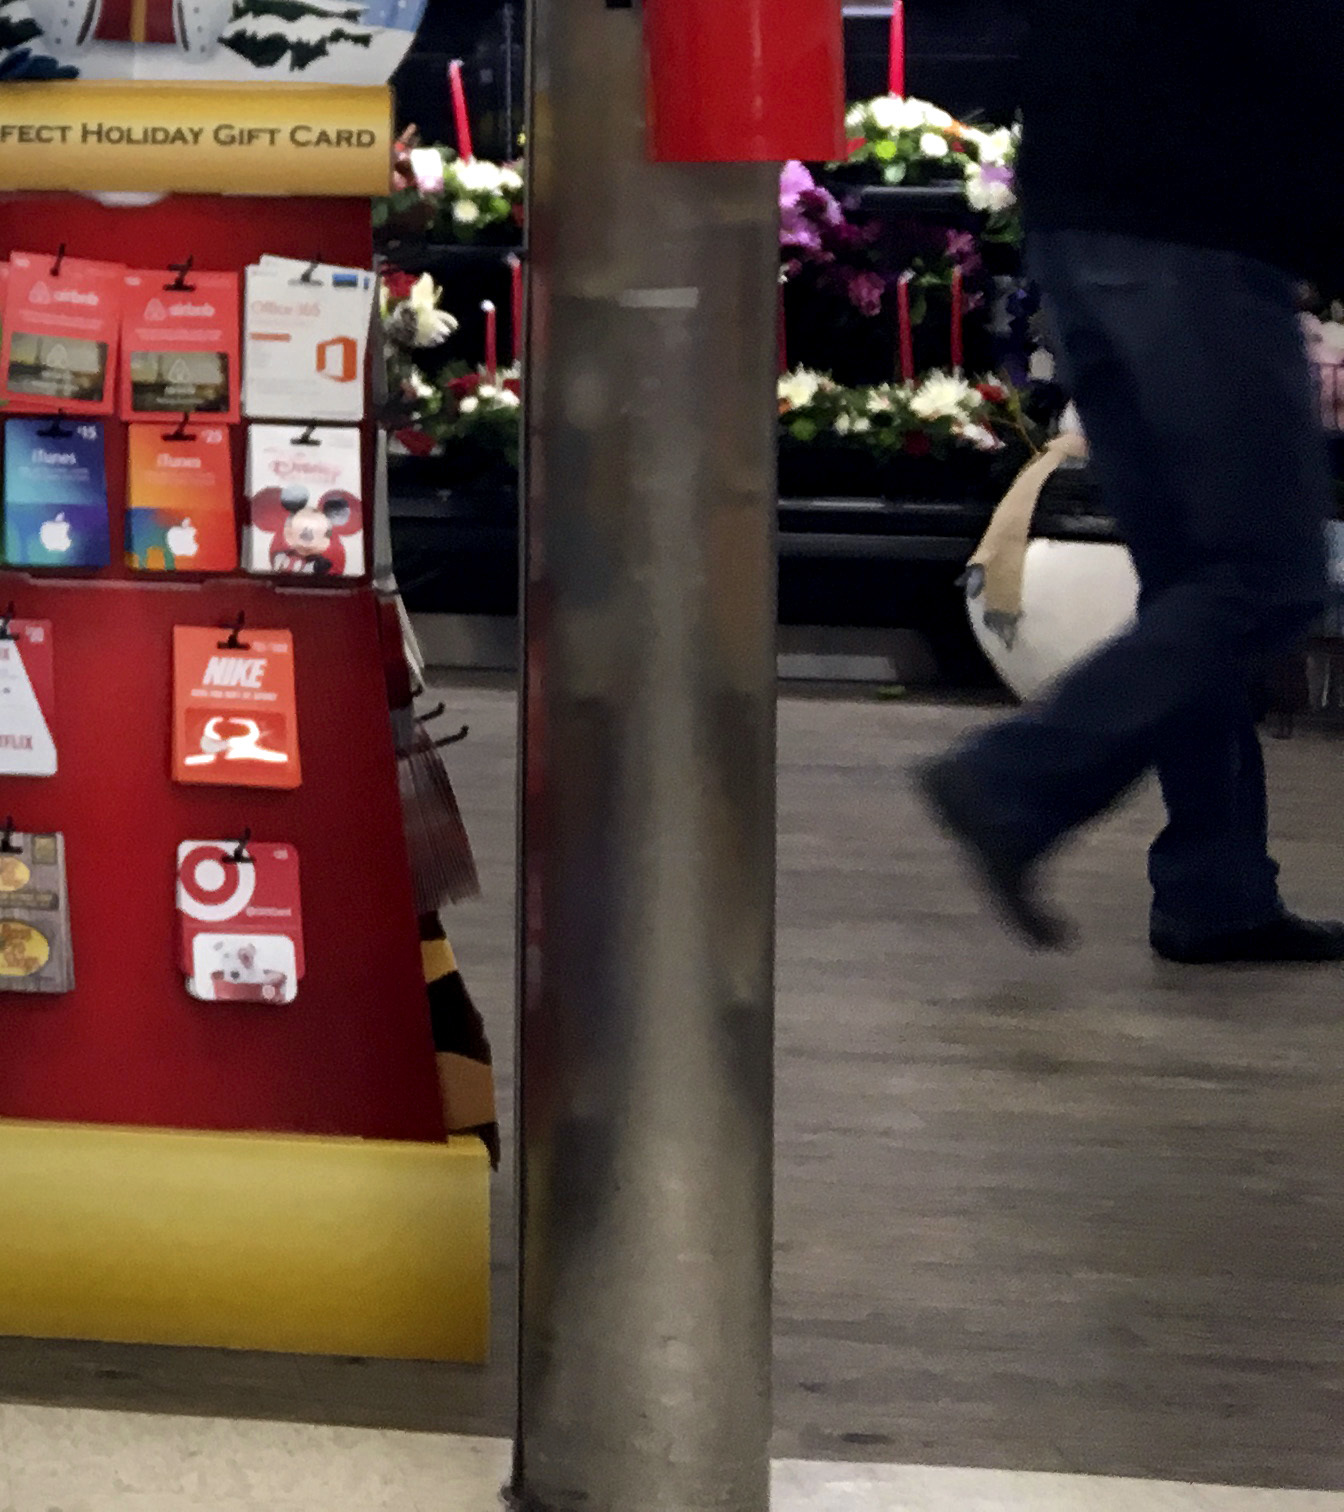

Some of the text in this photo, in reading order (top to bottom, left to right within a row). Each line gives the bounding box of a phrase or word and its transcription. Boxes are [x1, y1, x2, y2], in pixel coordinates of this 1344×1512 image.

[80, 121, 205, 146] HOLIDAY
[212, 123, 282, 147] GIFT
[289, 124, 377, 149] CARD
[201, 655, 268, 689] NIKE
